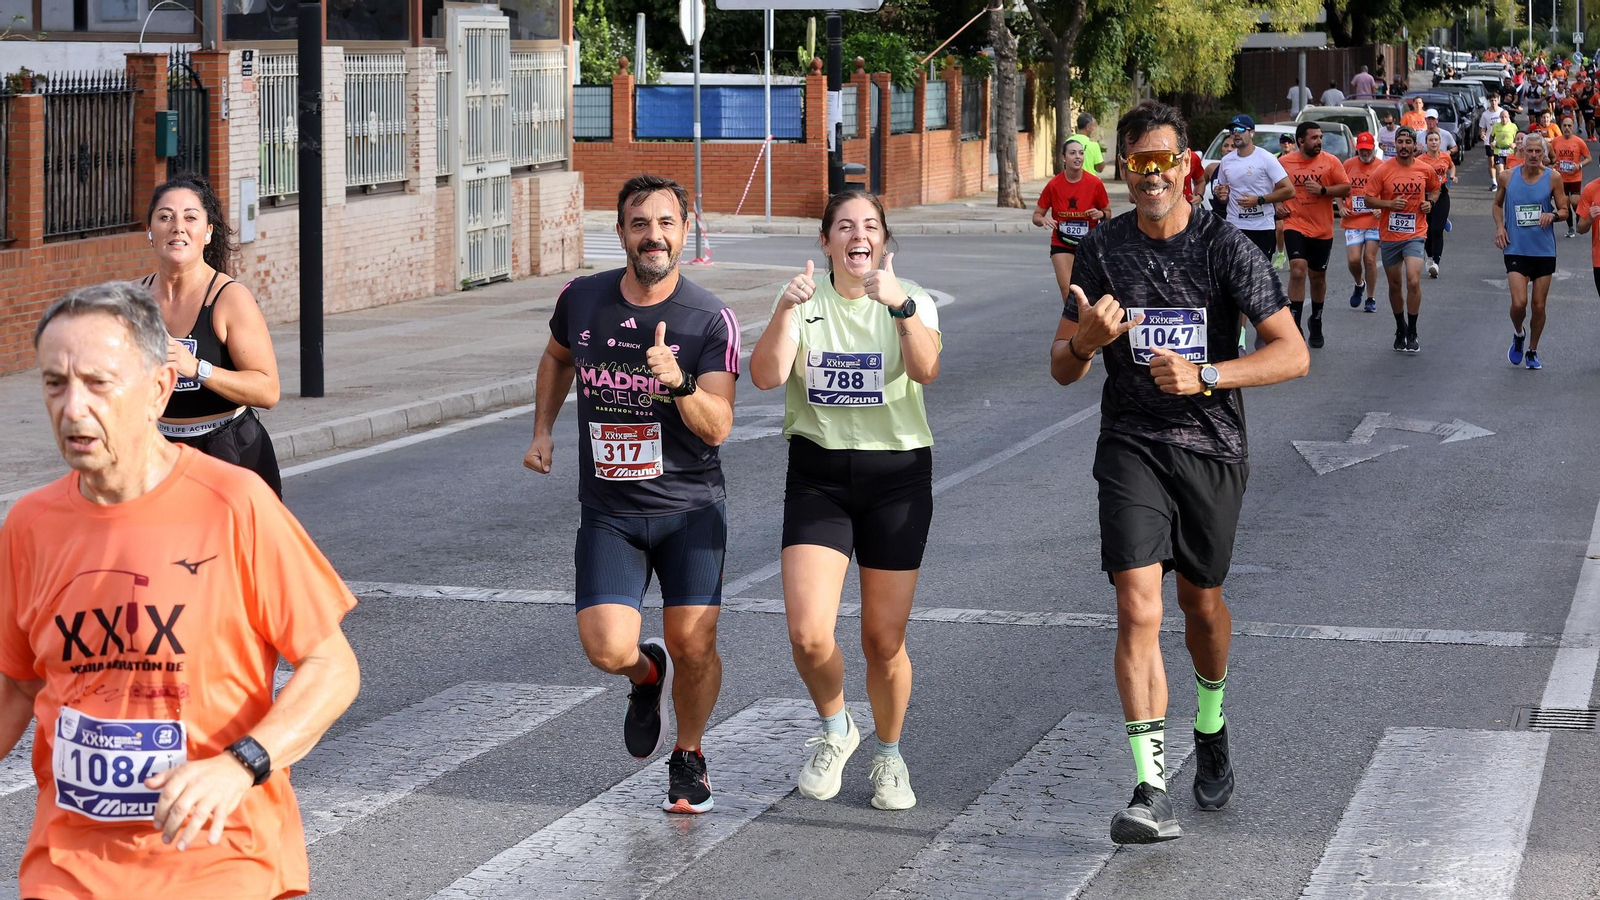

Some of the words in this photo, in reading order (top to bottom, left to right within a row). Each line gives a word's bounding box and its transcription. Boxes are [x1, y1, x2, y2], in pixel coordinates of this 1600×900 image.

[1351, 177, 1368, 186] XXI
[1393, 182, 1421, 193] XXIX
[1396, 219, 1411, 227] 892
[1066, 226, 1082, 234] 820
[1141, 327, 1194, 347] 1047
[617, 341, 641, 349] ZURICH
[580, 366, 670, 395] MADRID
[823, 370, 865, 390] 788
[190, 423, 217, 432] ACTIVE
[603, 443, 642, 462] 317
[55, 604, 186, 662] XXIX
[165, 661, 184, 672] DE
[81, 731, 115, 749] XXIX
[159, 730, 173, 739] 21
